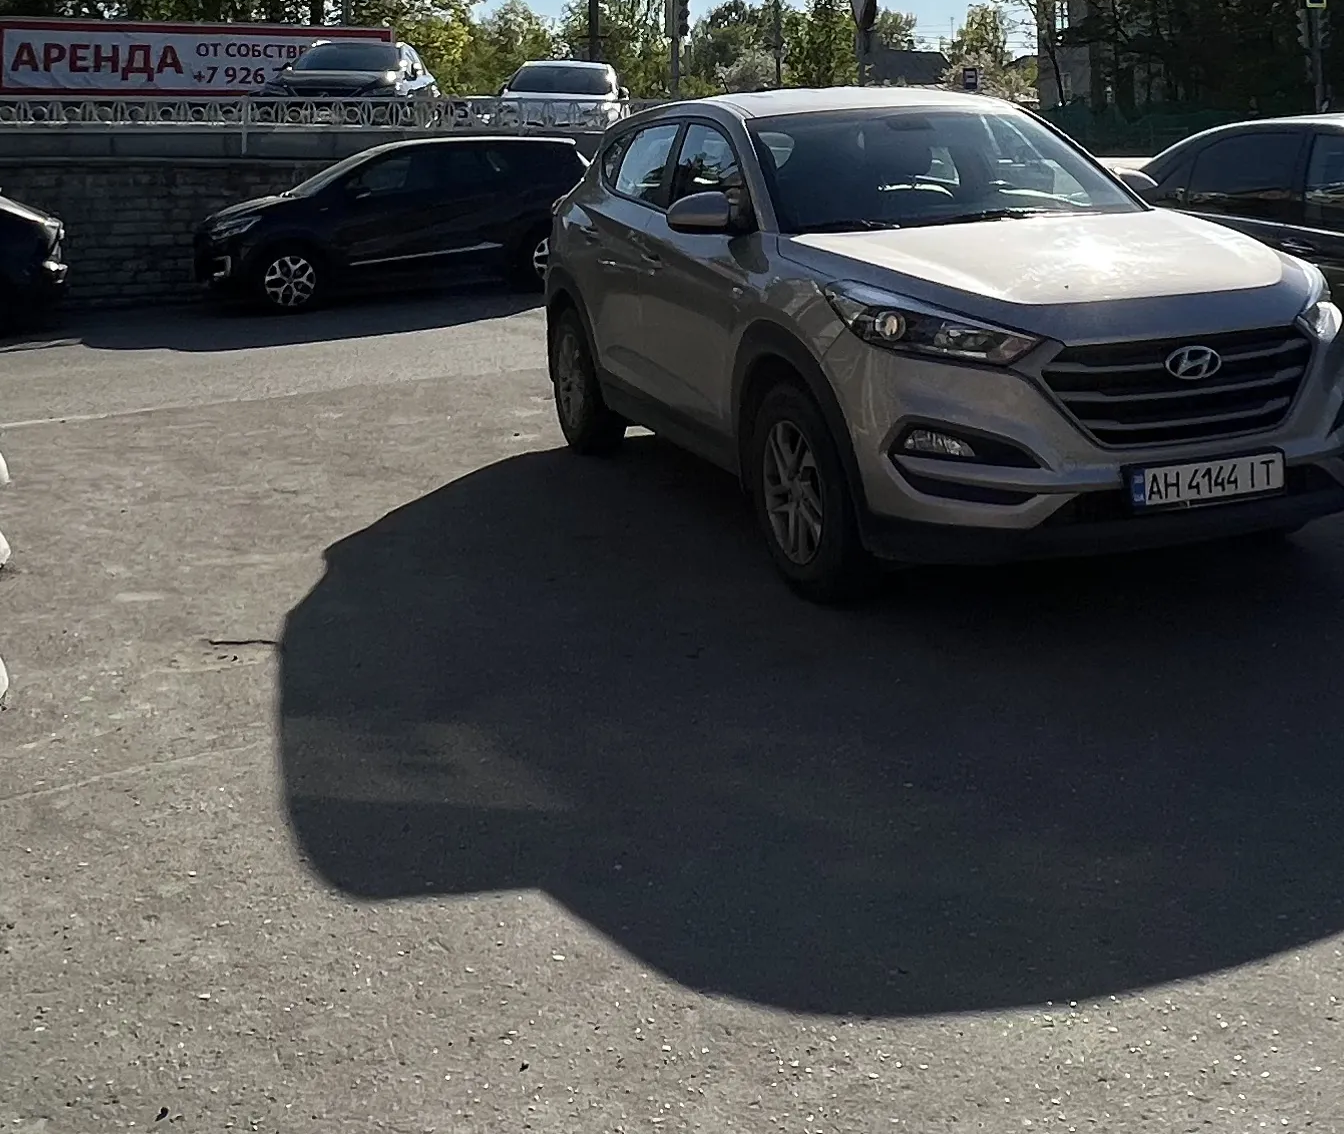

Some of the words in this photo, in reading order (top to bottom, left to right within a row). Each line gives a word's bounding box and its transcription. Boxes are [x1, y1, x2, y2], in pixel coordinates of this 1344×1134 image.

[10, 42, 185, 82] АРЕНДА
[195, 42, 222, 58] ОТ
[193, 66, 219, 85] +7
[223, 66, 267, 86] 926
[1187, 463, 1240, 496] 4144
